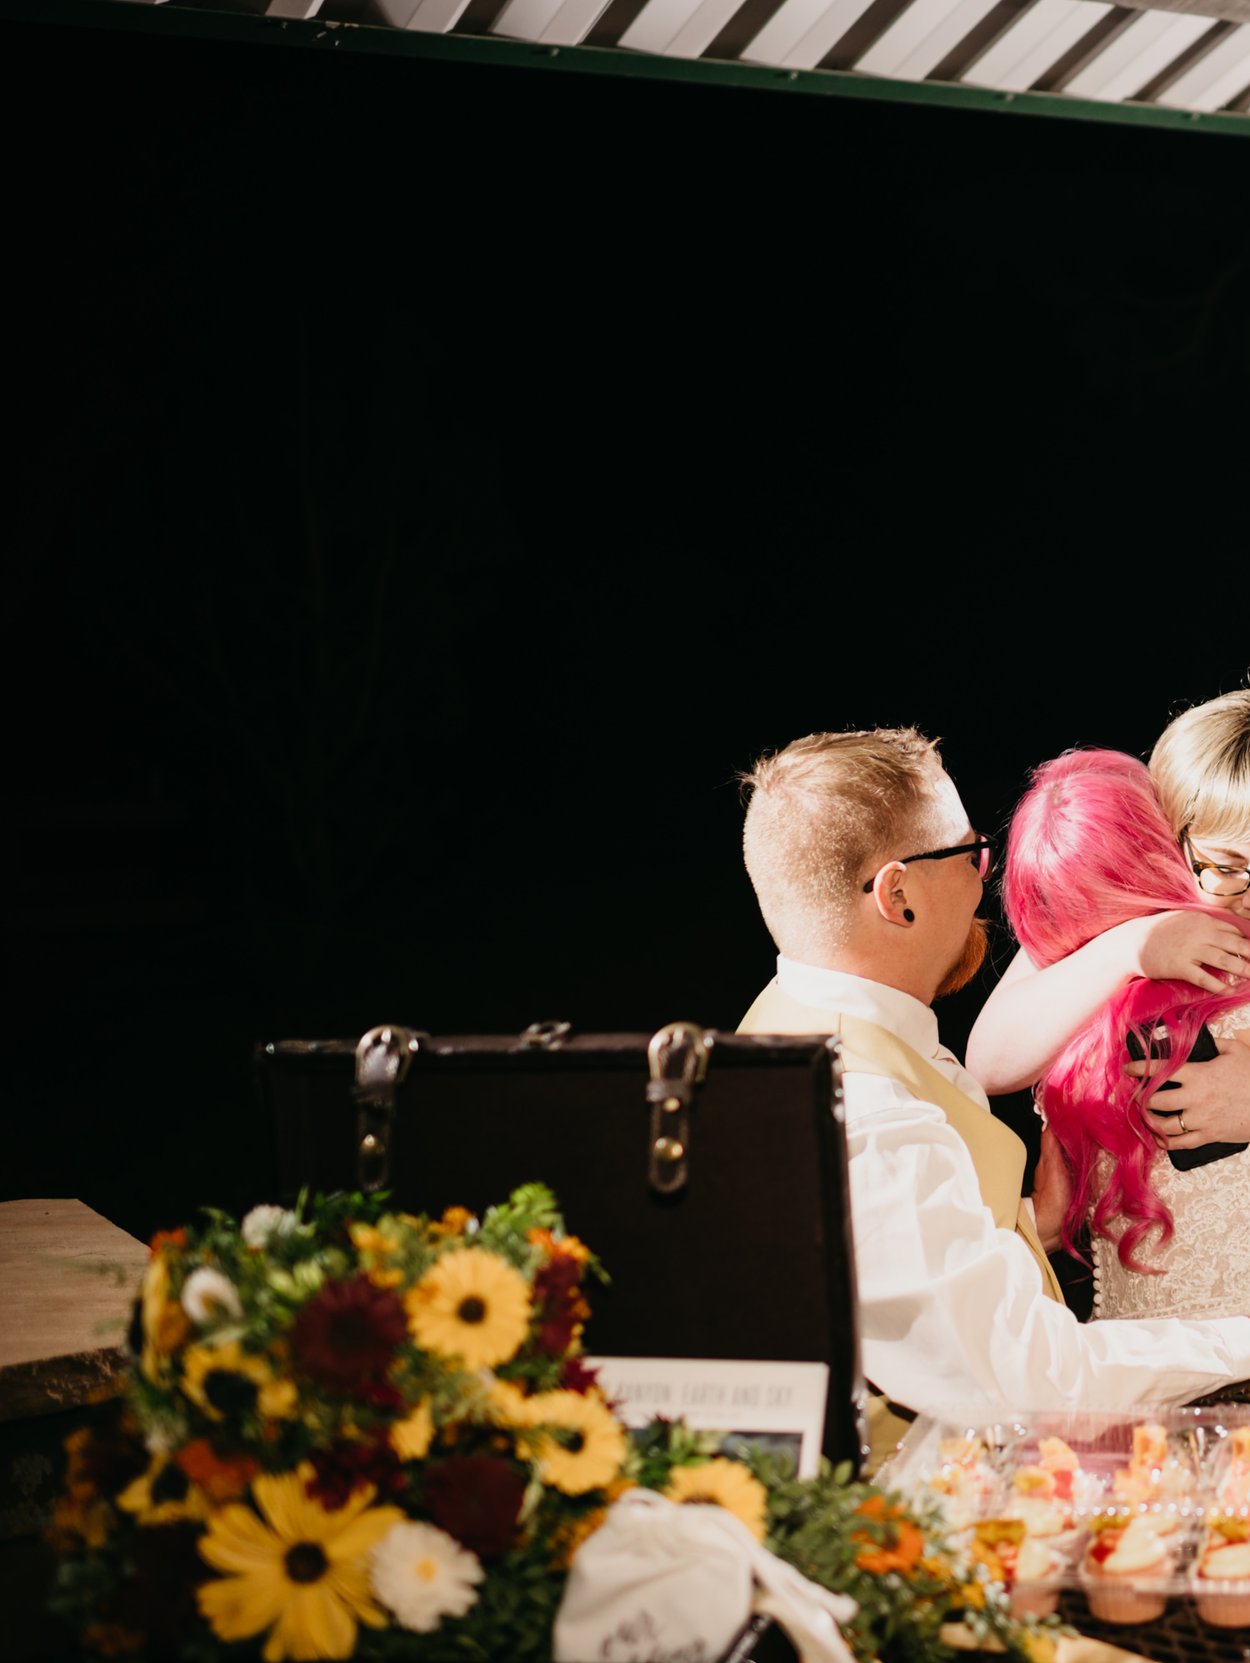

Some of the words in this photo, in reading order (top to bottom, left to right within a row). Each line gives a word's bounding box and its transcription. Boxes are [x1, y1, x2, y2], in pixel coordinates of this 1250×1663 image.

[681, 1382, 726, 1405] EARTH
[731, 1384, 761, 1407] AND
[766, 1384, 794, 1407] SKY
